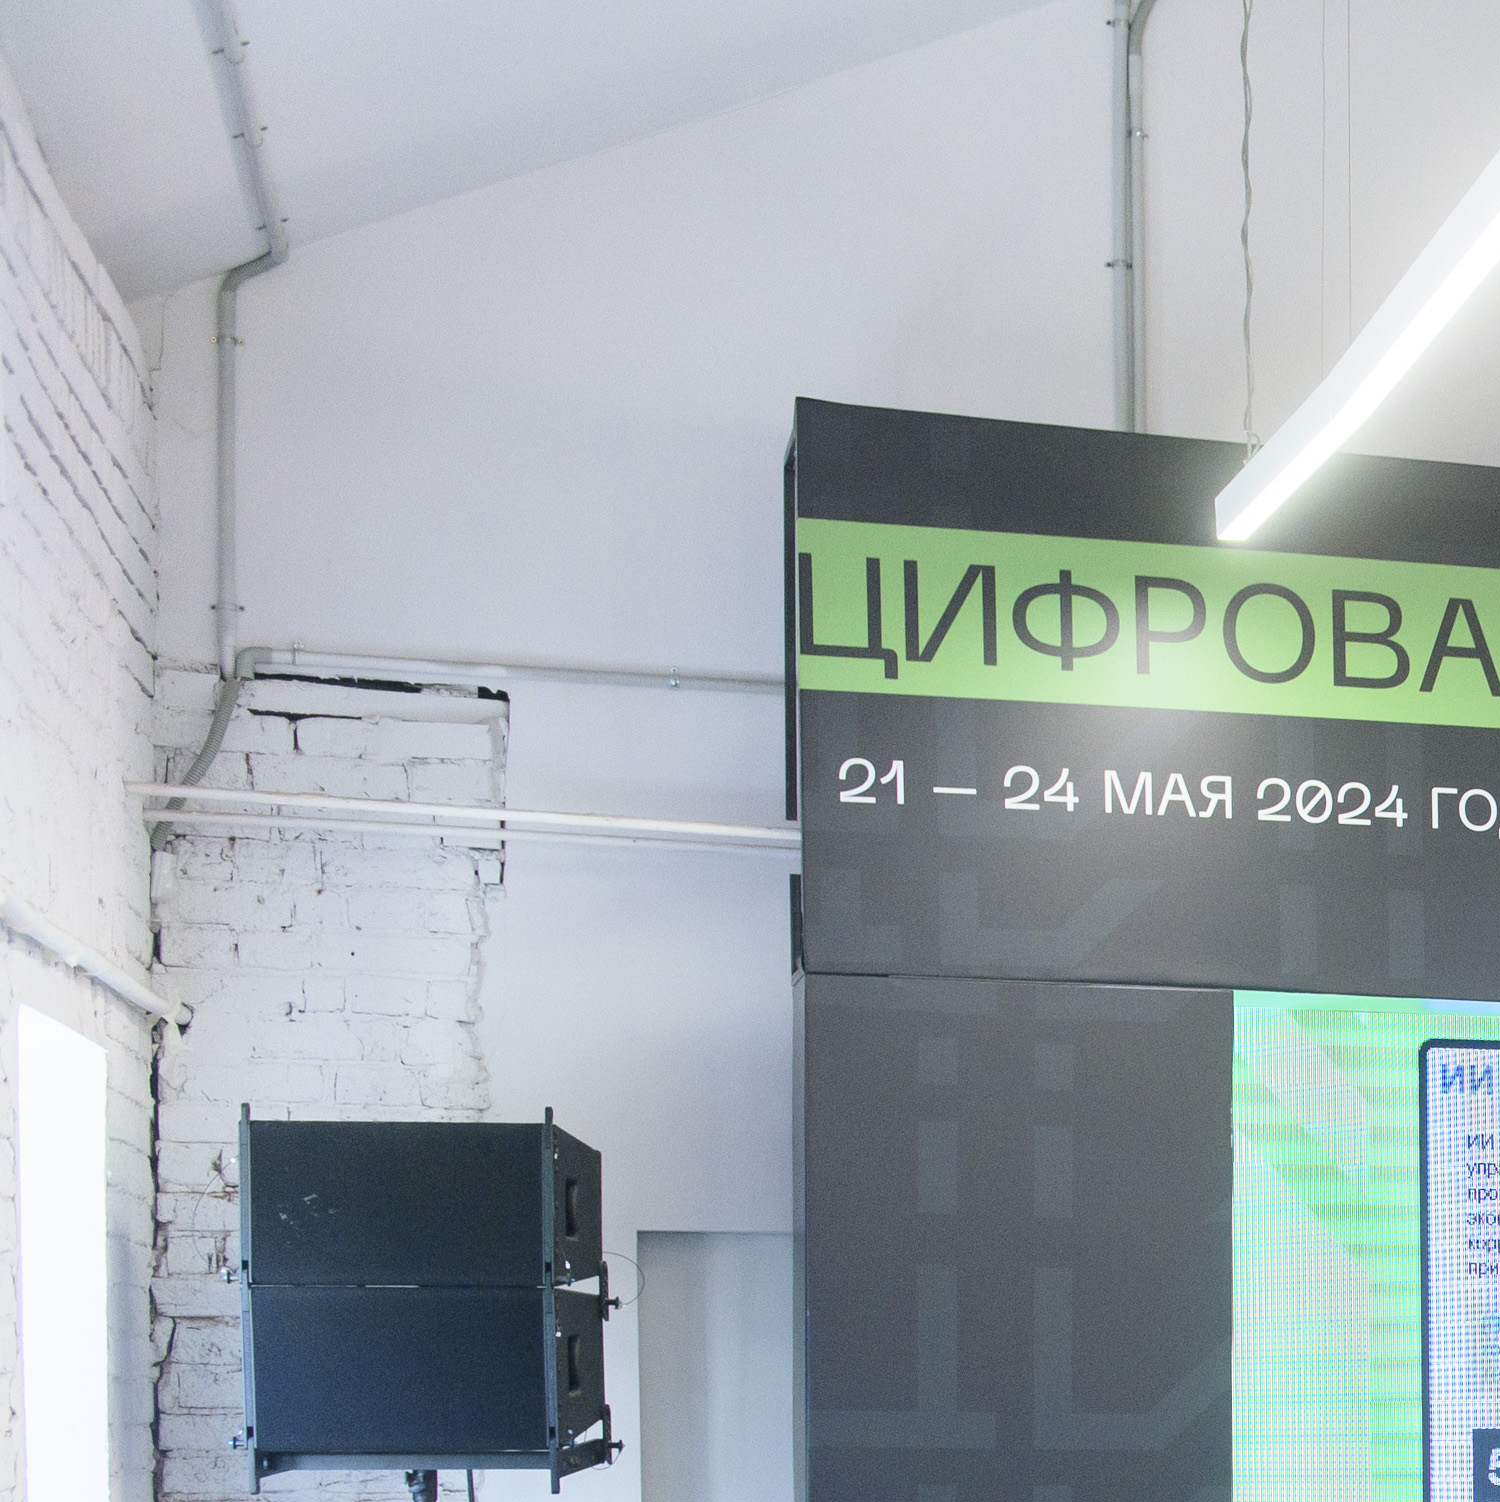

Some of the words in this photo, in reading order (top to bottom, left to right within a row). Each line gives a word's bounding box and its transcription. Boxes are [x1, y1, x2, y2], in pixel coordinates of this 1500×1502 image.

[837, 757, 907, 805] 21
[1002, 765, 1080, 813] 24
[1103, 770, 1235, 820] МАЯ
[1256, 777, 1409, 829] 2024
[1441, 1064, 1493, 1096] ИИ
[1467, 1134, 1495, 1151] ИИ
